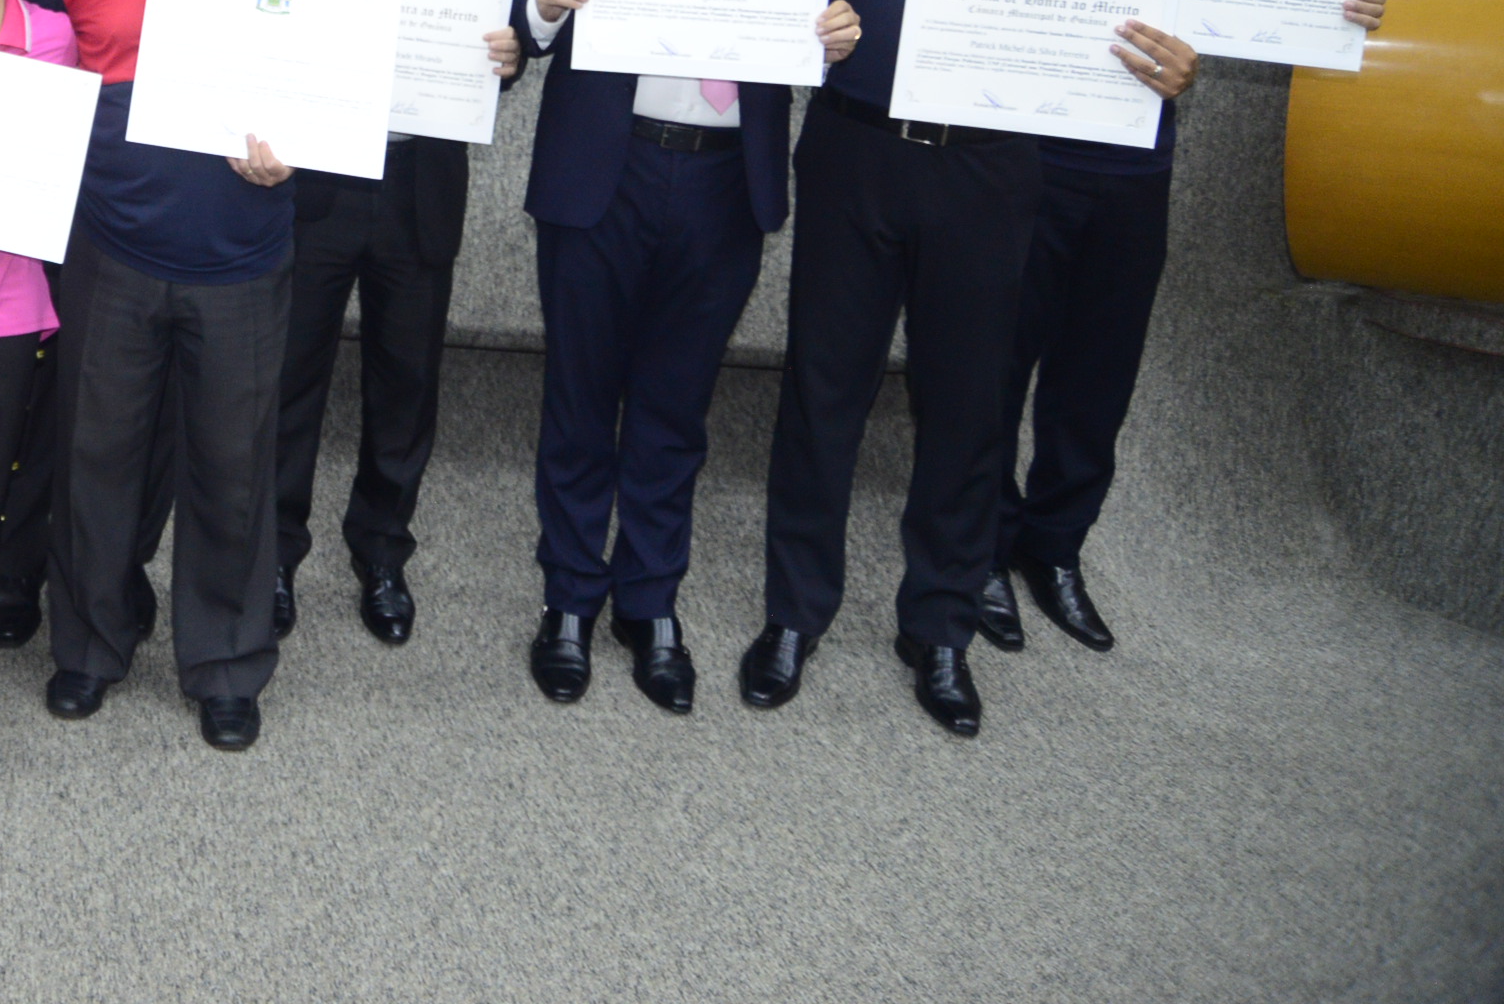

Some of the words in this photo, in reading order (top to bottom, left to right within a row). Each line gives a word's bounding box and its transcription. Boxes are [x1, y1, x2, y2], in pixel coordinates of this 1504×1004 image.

[1071, 0, 1087, 11] ao
[1091, 0, 1140, 16] Mérito
[970, 40, 996, 51] Patrick
[1038, 46, 1057, 57] Silva
